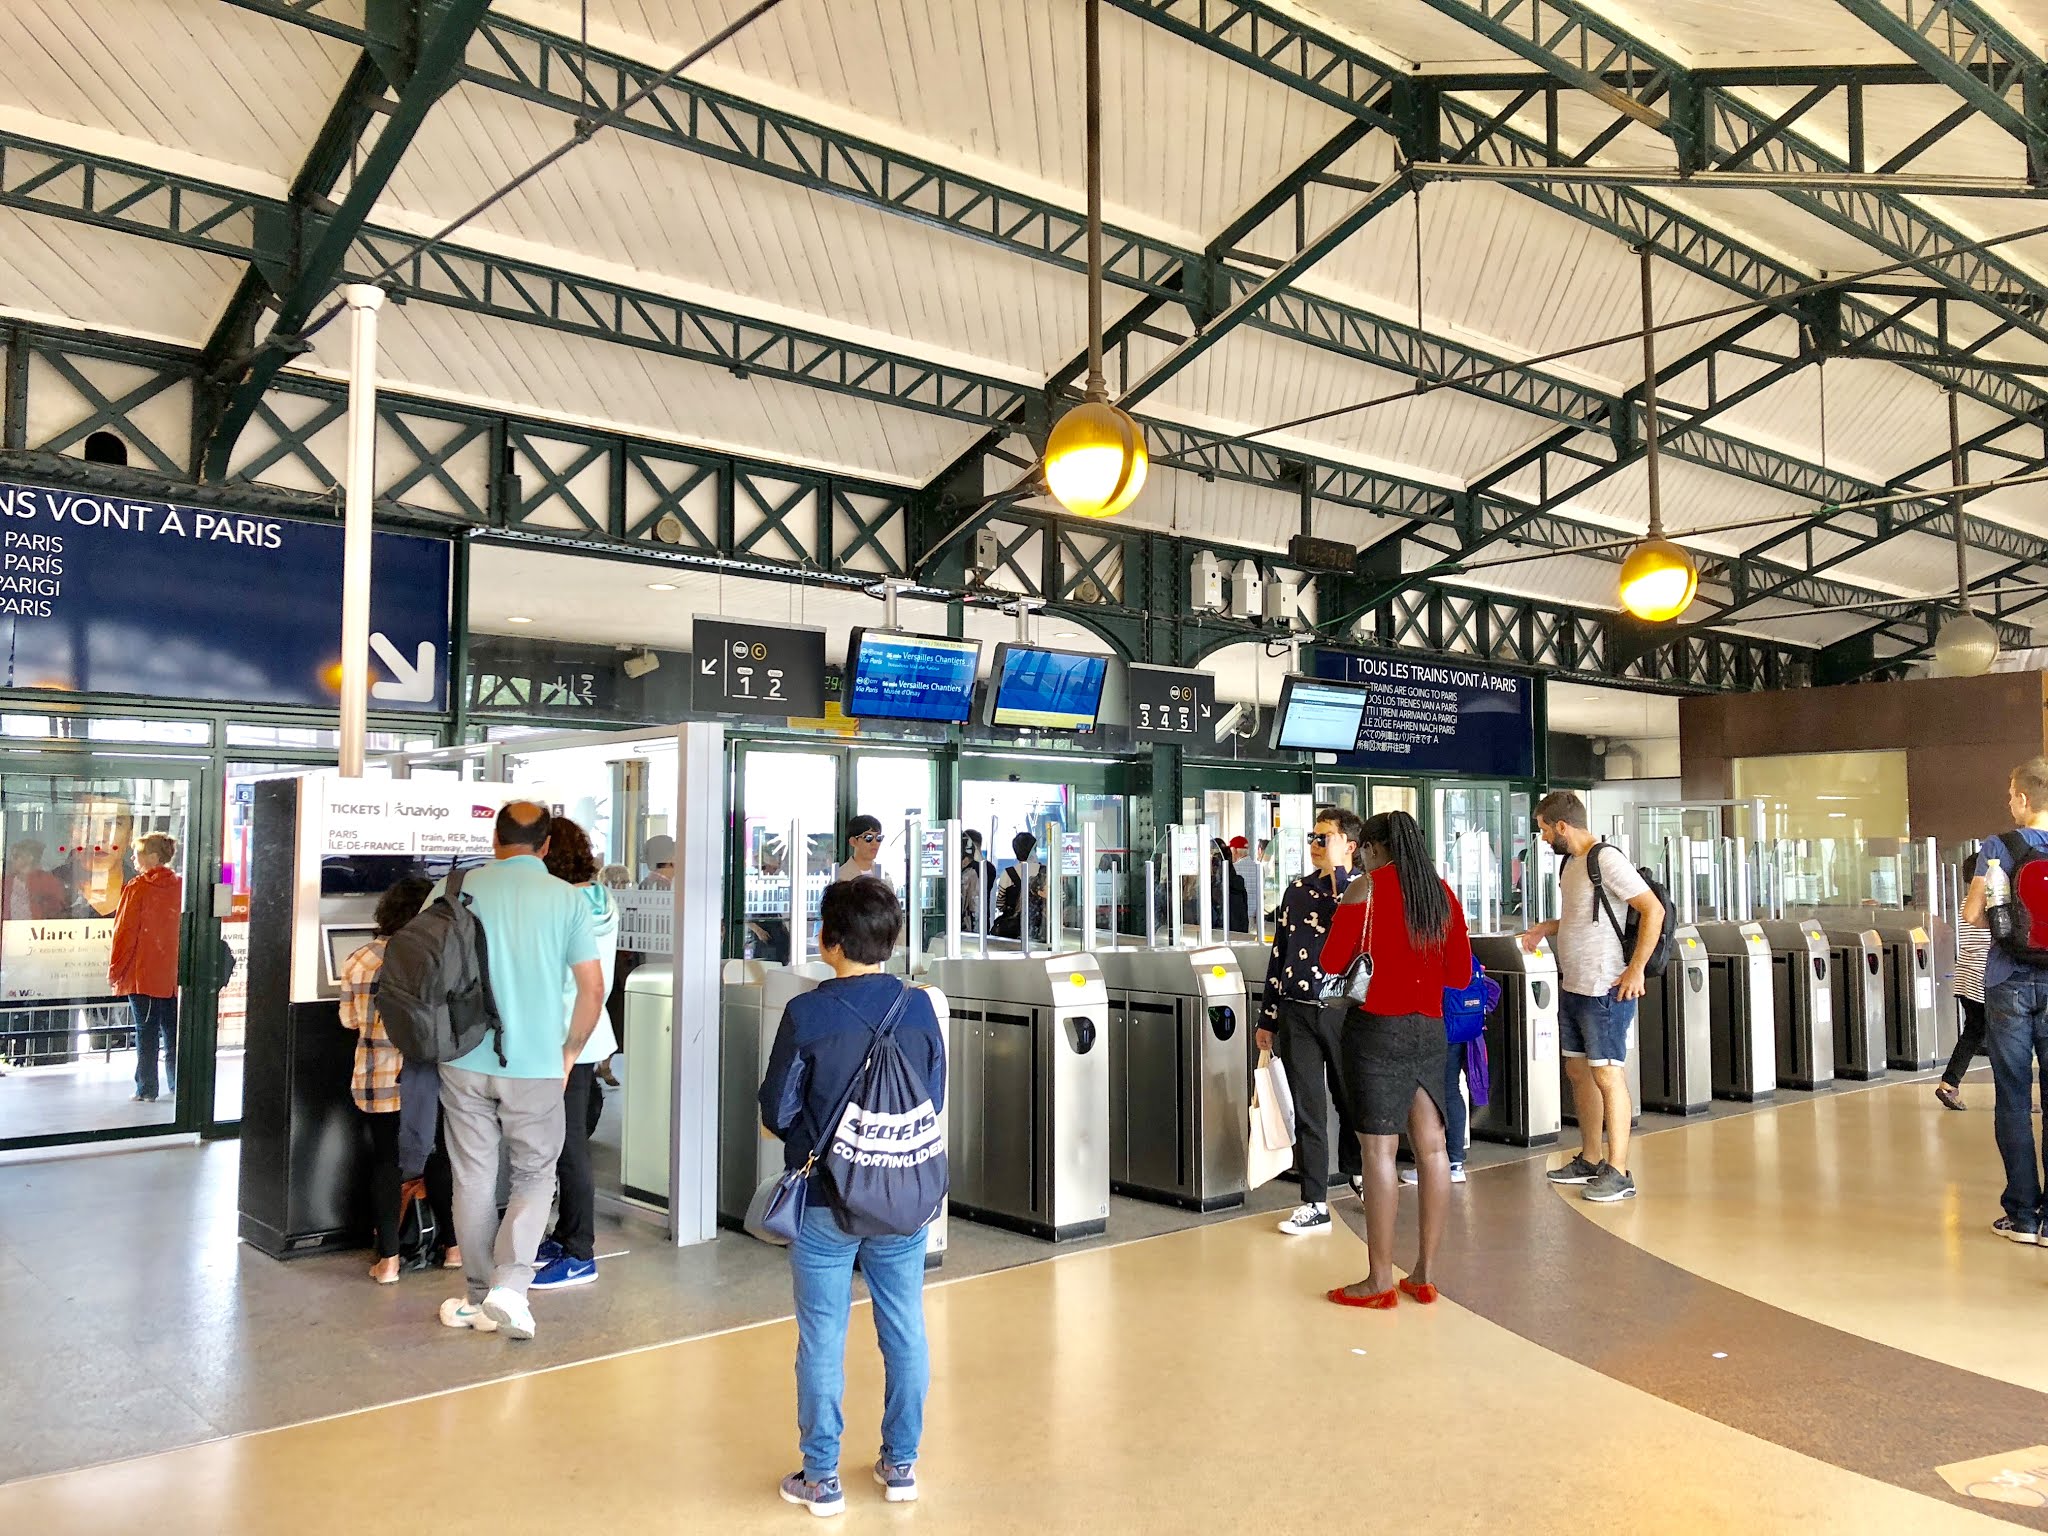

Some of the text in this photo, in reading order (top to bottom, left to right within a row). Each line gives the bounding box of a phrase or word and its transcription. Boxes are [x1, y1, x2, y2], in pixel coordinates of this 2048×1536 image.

[46, 494, 152, 531] VONT
[159, 504, 187, 536] À
[195, 514, 283, 548] PARIS
[5, 531, 63, 553] PARIS
[5, 553, 63, 575] PARÍS
[903, 652, 933, 662] Versailles
[935, 654, 966, 665] Chantiers
[1357, 658, 1517, 693] TOUS LES TRAINS VONT À PARIS
[582, 681, 592, 695] 2
[740, 676, 781, 697] 1 2
[899, 680, 930, 690] Versailles
[931, 682, 962, 693] Chantiers
[1369, 682, 1393, 694] TRAINS
[1394, 686, 1407, 696] ARE
[1408, 687, 1430, 698] GOING
[1431, 690, 1440, 699] TO
[1441, 691, 1458, 702] PARIS
[1383, 696, 1396, 706] LOS
[1397, 697, 1421, 709] TRENES
[1421, 701, 1435, 711] VAN
[1435, 703, 1441, 711] A
[1441, 702, 1458, 713] PARÍS
[1141, 711, 1188, 729] 3 4 5
[1380, 707, 1398, 718] TRENI
[1399, 709, 1431, 722] ARRIVANO
[1432, 714, 1437, 722] A
[1438, 714, 1458, 725] PARIGI
[1374, 716, 1392, 729] ZÜGE
[1393, 720, 1419, 731] FAHREN
[1420, 723, 1438, 734] NACH
[1439, 725, 1456, 735] PARIS
[331, 804, 449, 820] TICKETS navigo
[329, 830, 358, 839] PARIS
[421, 833, 489, 843] train, RER, bus,
[328, 840, 405, 851] ÎLE-DE-FRANCE
[421, 844, 493, 854] tramway, métro
[844, 1111, 935, 1140] SKECHERS
